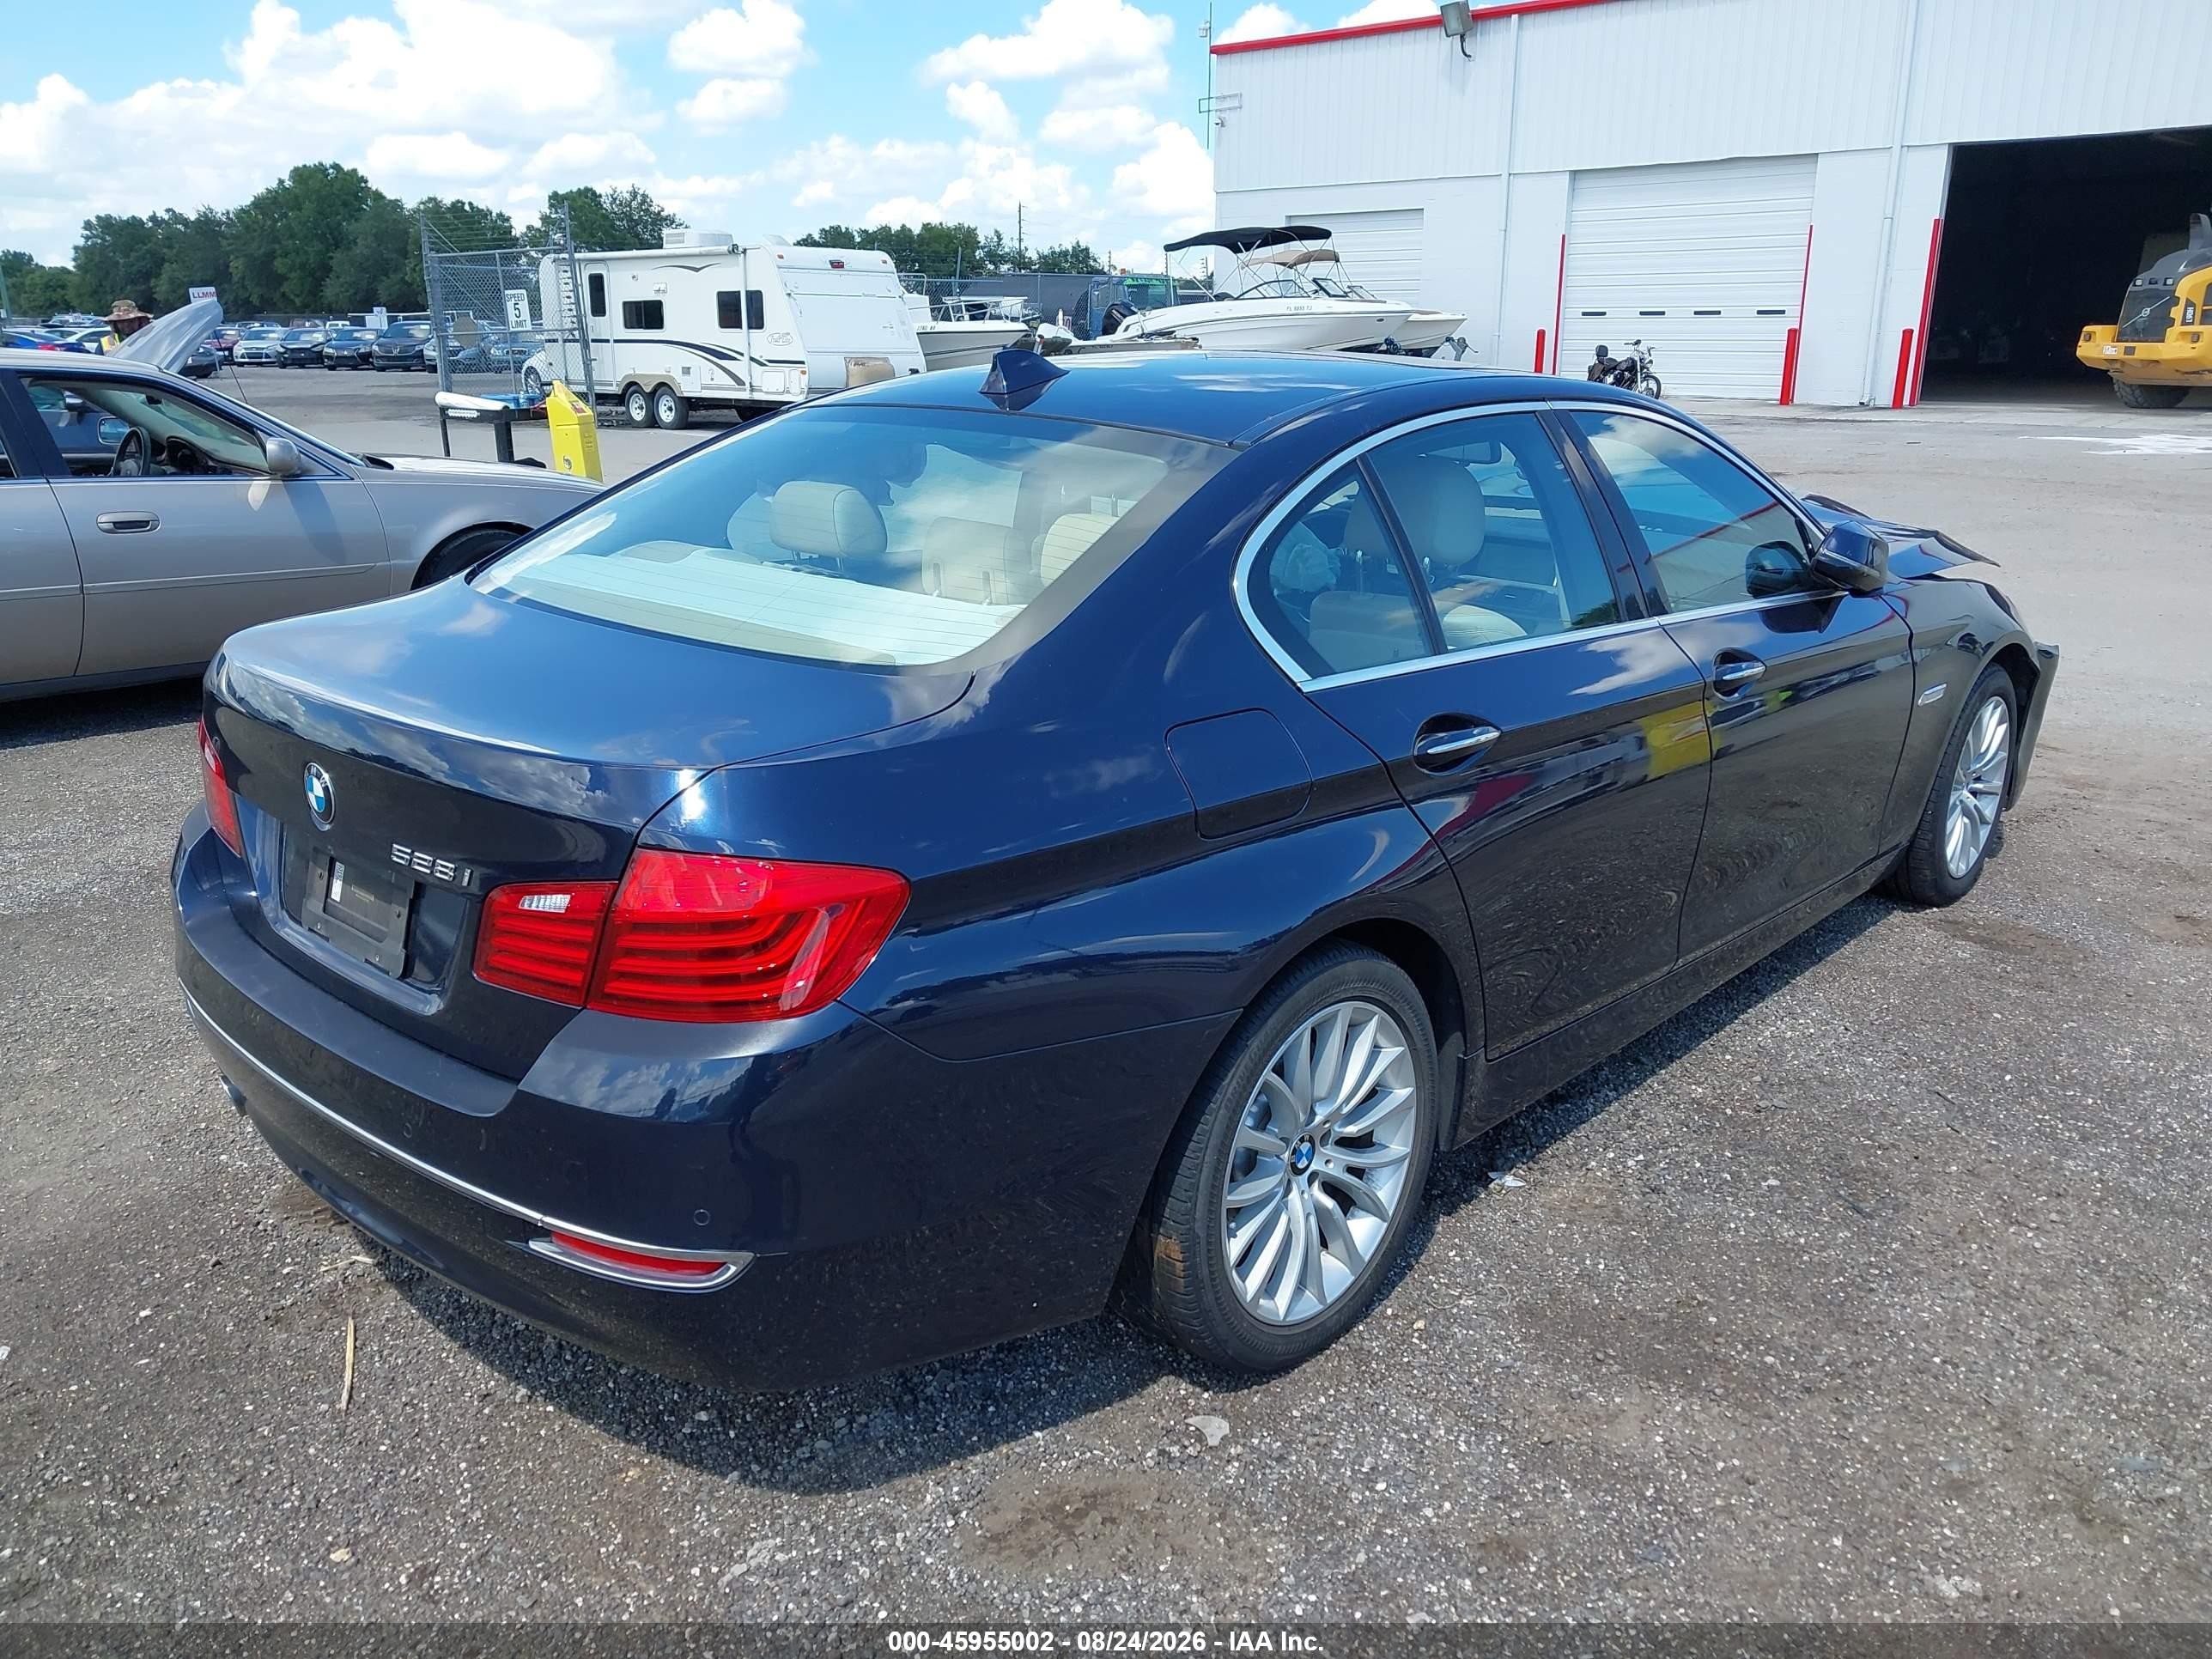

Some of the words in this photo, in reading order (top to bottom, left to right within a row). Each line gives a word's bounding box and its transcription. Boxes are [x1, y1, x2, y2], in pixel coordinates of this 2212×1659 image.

[507, 293, 525, 302] SPEED
[514, 302, 520, 319] 5
[511, 319, 526, 329] LIMIT
[1291, 1133, 1310, 1163] BMW
